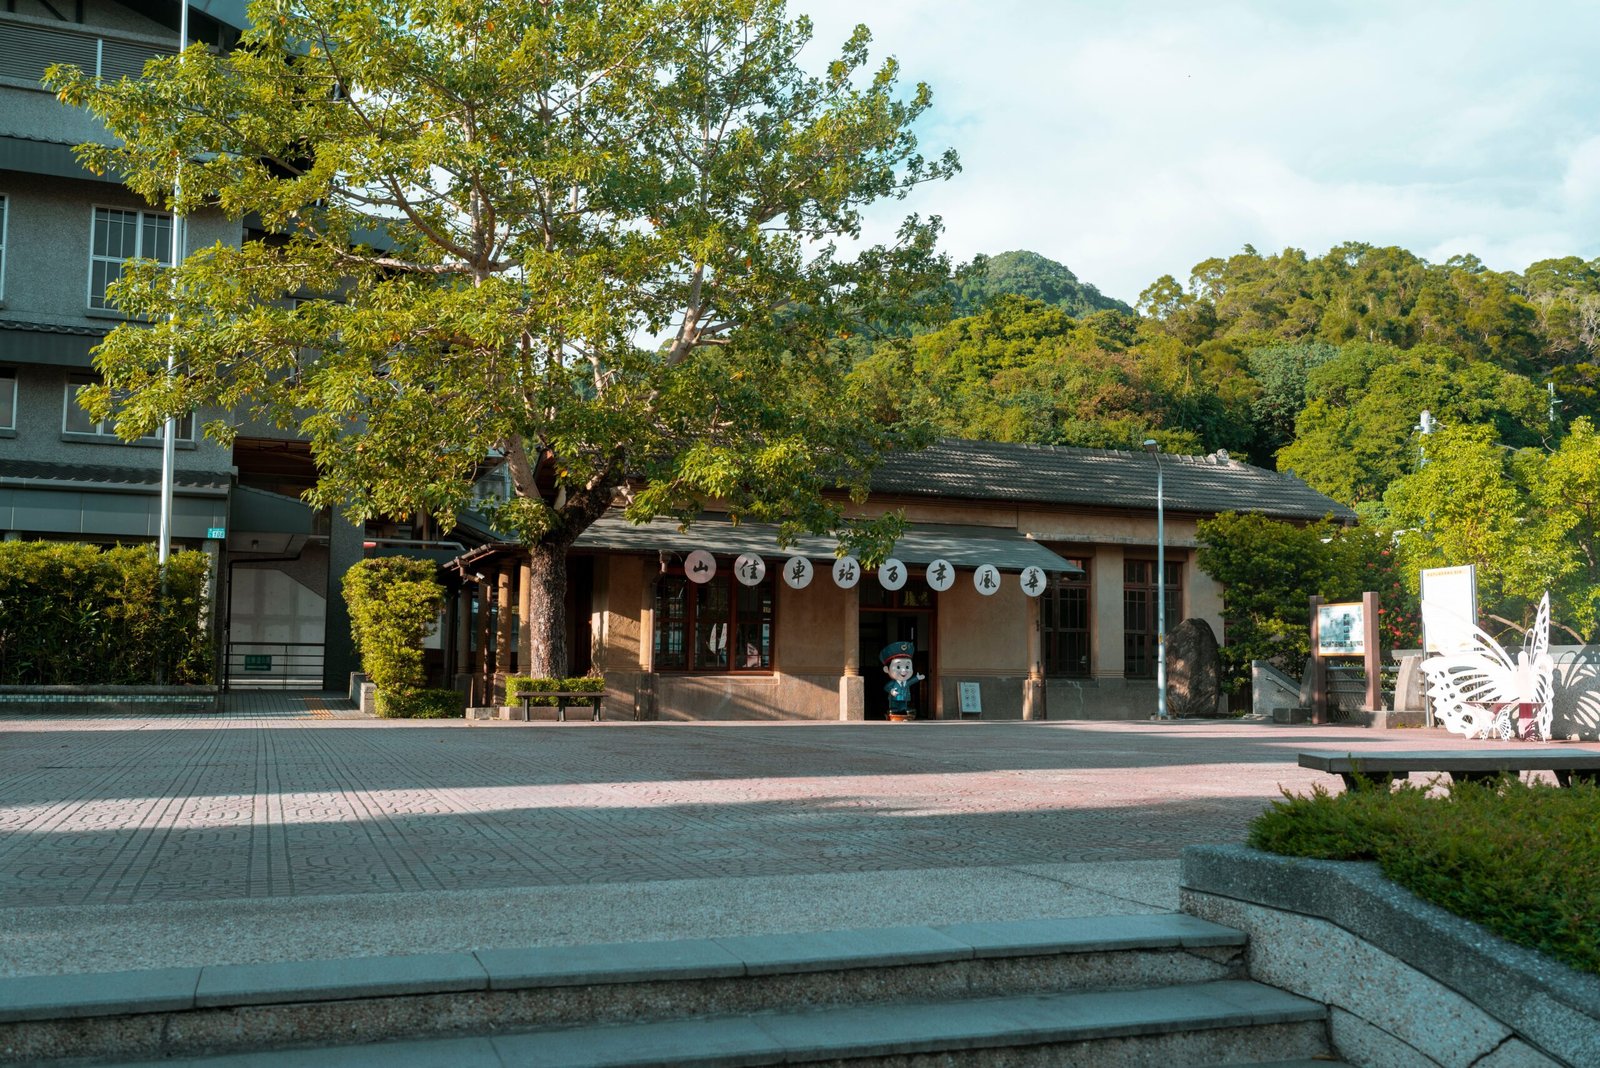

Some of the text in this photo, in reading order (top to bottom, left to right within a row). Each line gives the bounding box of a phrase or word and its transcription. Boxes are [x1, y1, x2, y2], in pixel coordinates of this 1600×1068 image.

[692, 559, 1039, 593] 山佳車站百年風華
